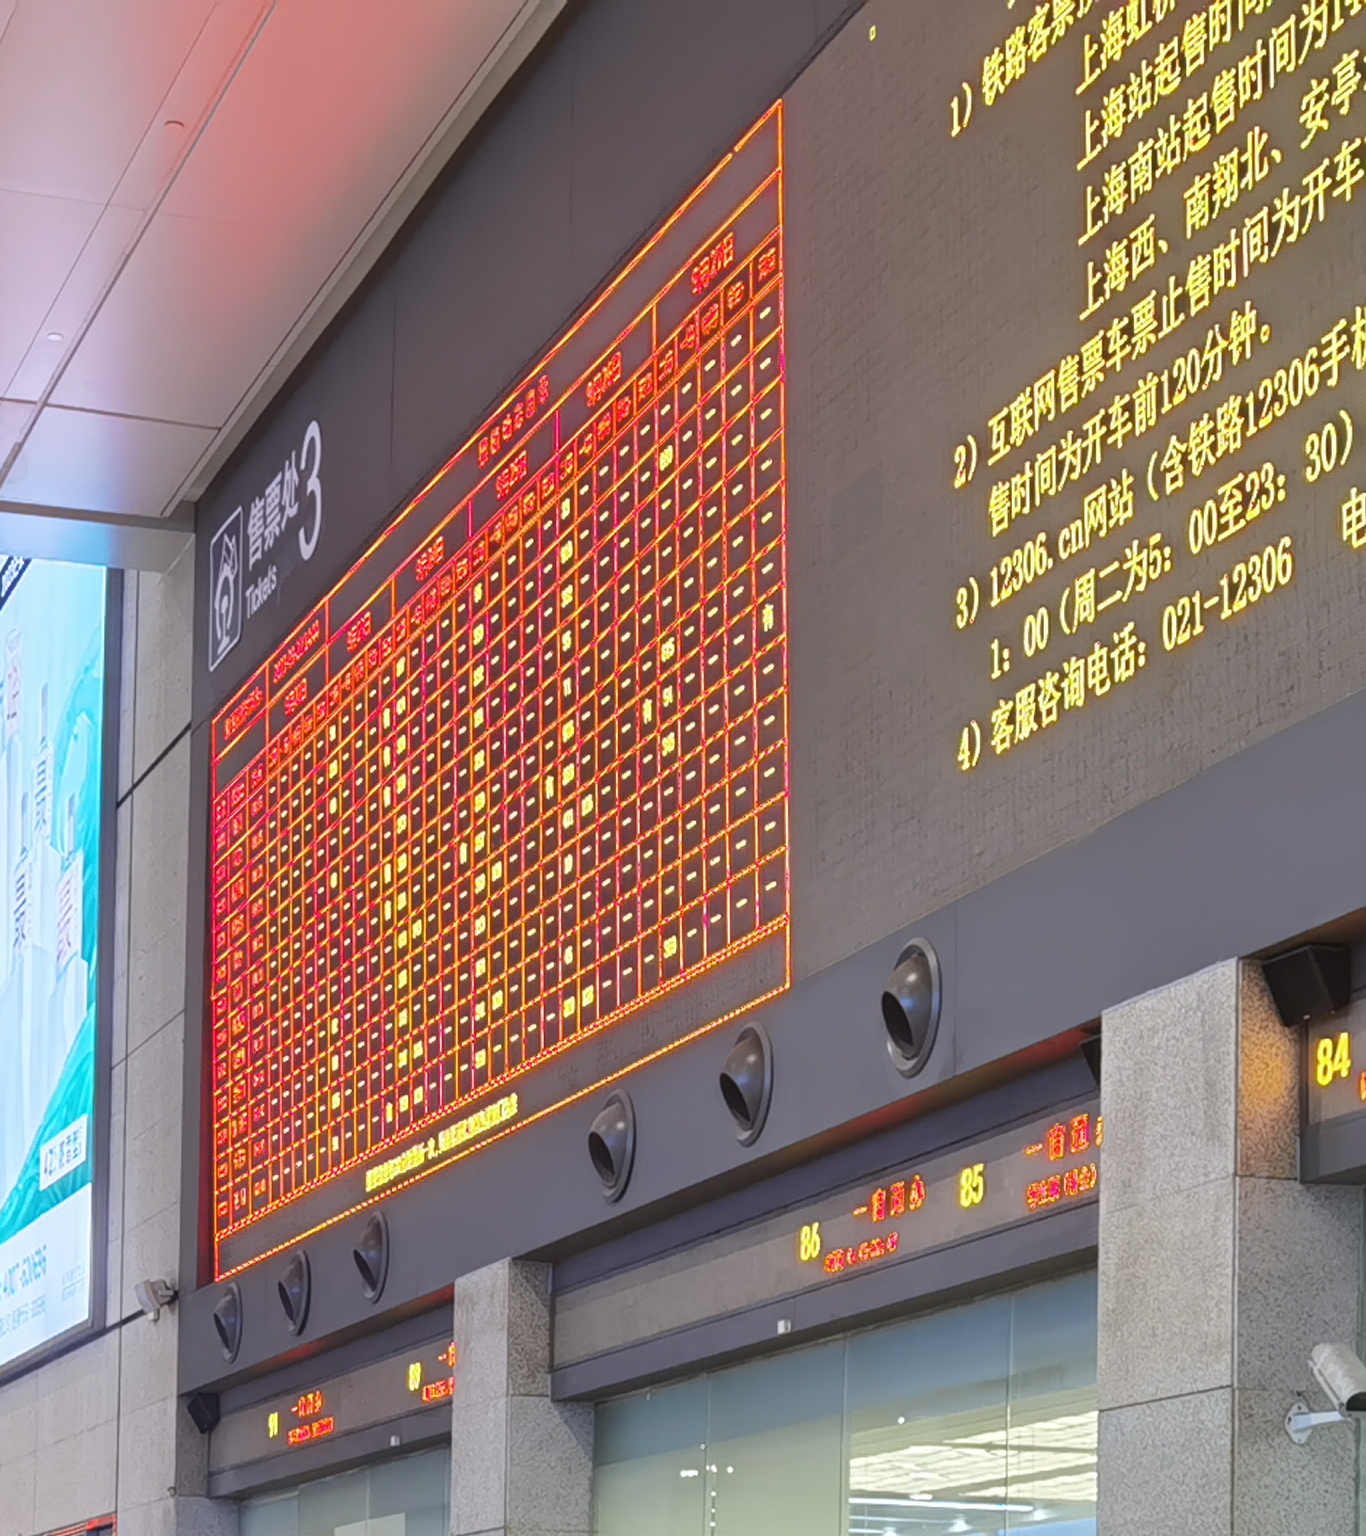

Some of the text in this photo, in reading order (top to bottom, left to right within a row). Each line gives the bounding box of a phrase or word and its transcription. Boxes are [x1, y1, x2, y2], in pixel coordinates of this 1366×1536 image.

[247, 450, 299, 570] 售票处
[298, 420, 322, 561] 3
[245, 564, 278, 620] Tickets
[1316, 1032, 1352, 1086] 84
[959, 1163, 985, 1208] 85
[799, 1222, 821, 1261] 86
